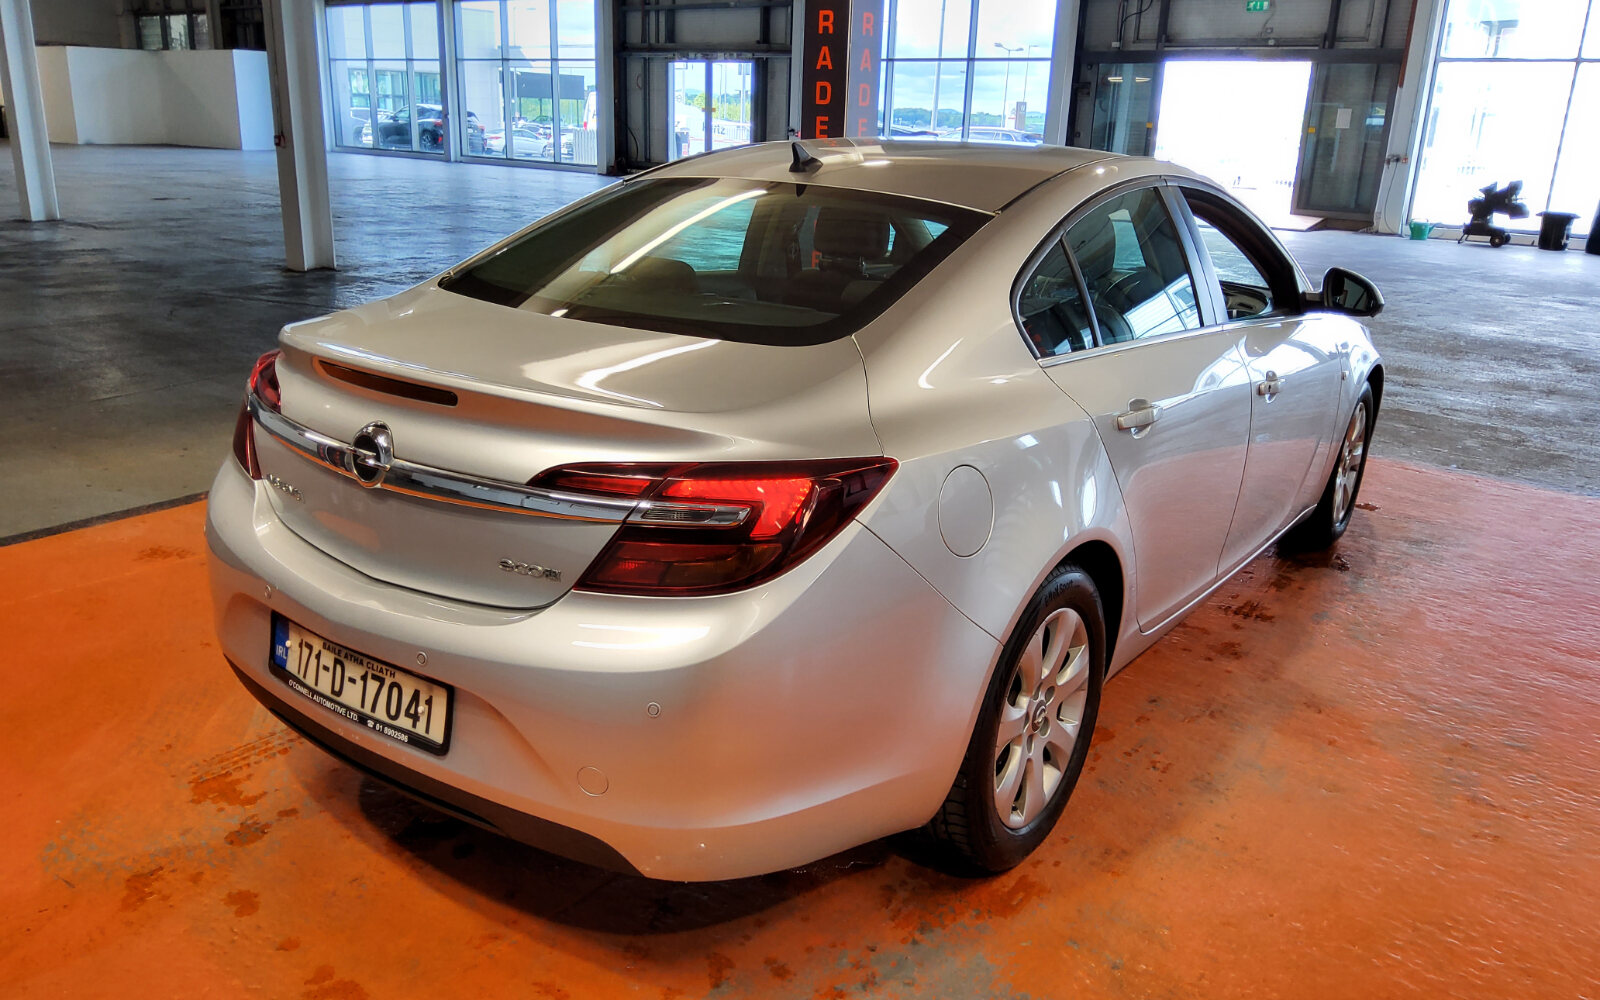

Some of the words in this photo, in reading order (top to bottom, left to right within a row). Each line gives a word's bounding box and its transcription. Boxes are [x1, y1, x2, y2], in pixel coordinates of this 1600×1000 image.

[816, 9, 835, 139] RADE
[275, 644, 288, 660] IRL
[322, 641, 343, 657] BAILE
[366, 661, 396, 679] CLIATH
[288, 679, 313, 699] O'CONNELL
[313, 694, 347, 716] AUTOMOTIVE
[375, 723, 383, 732] 01
[298, 638, 433, 735] 171-D-17041
